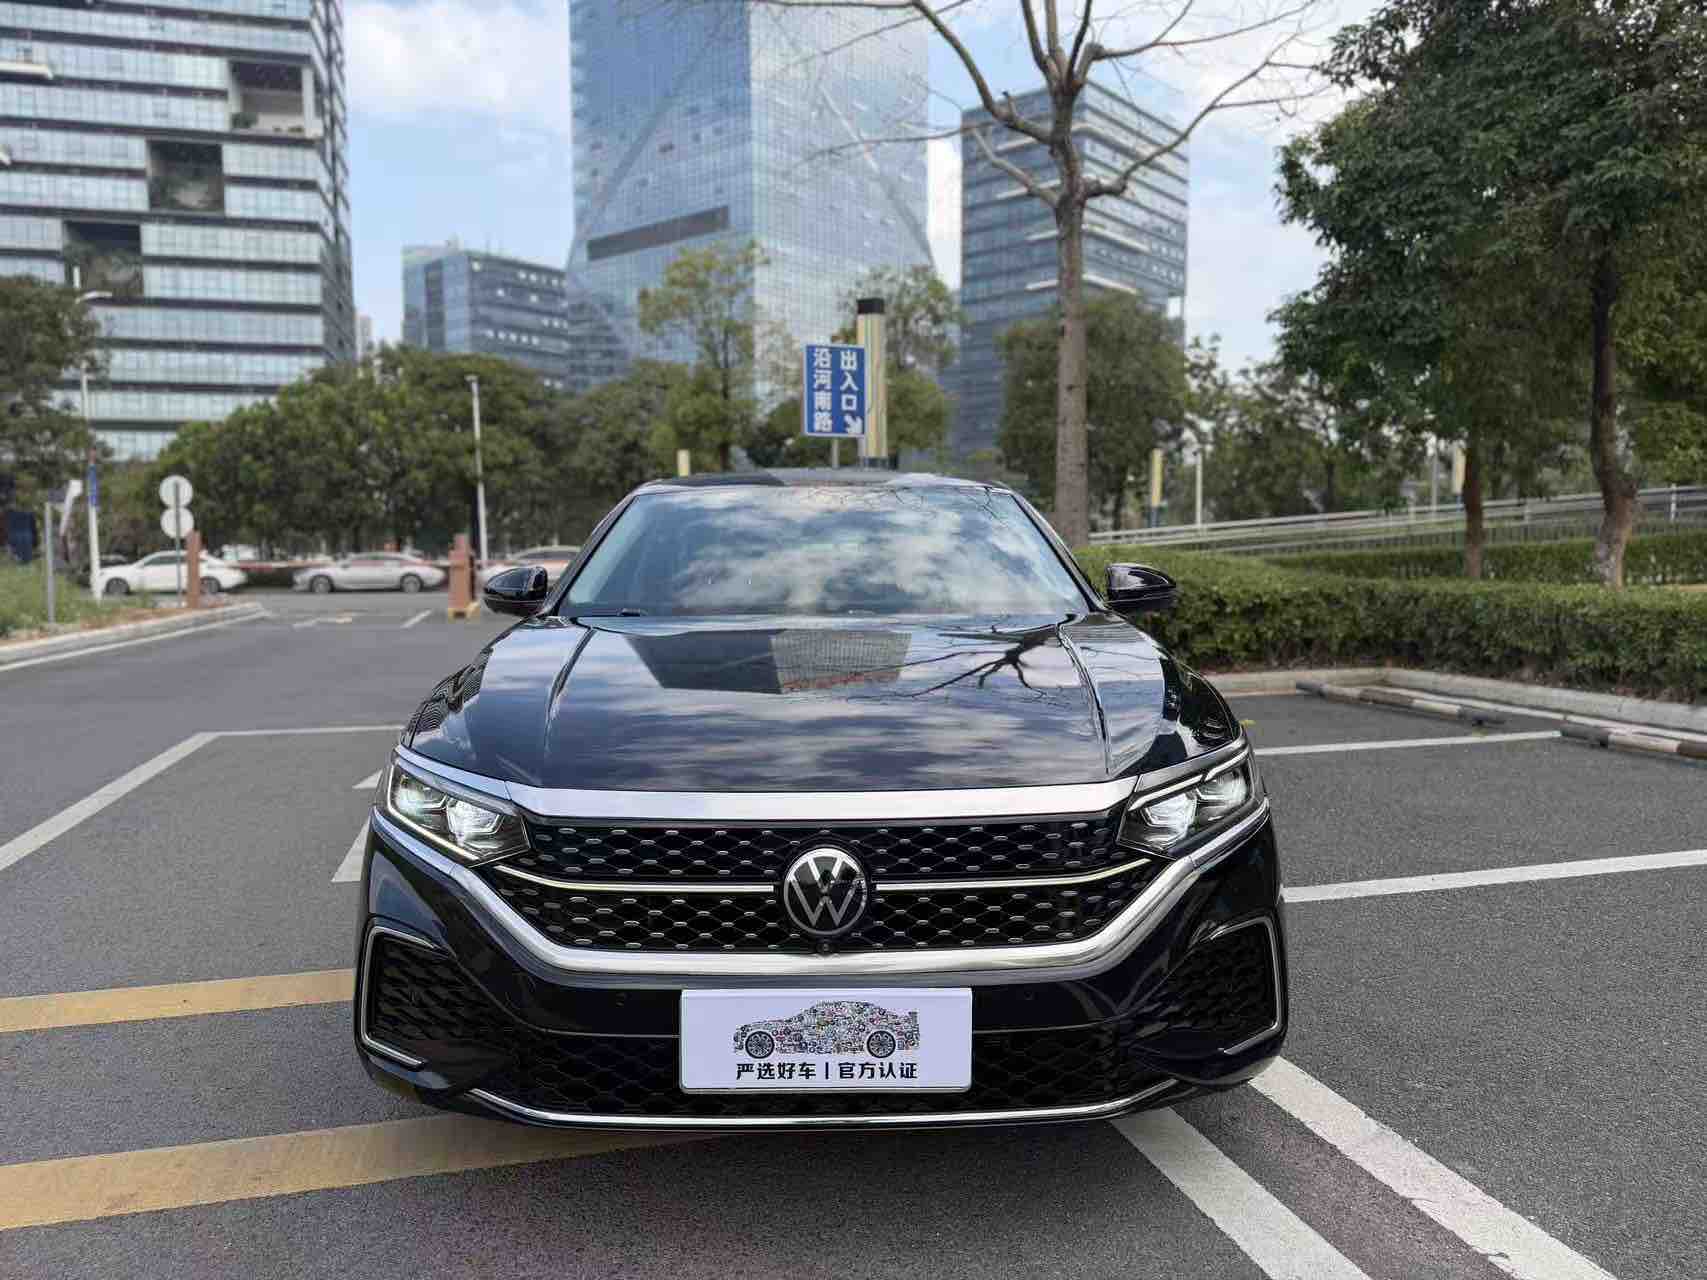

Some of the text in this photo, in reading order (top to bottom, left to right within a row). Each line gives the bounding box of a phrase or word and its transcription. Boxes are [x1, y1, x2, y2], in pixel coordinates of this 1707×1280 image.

[840, 350, 859, 411] 出入口
[736, 1062, 918, 1080] 严选好车 官方认证
